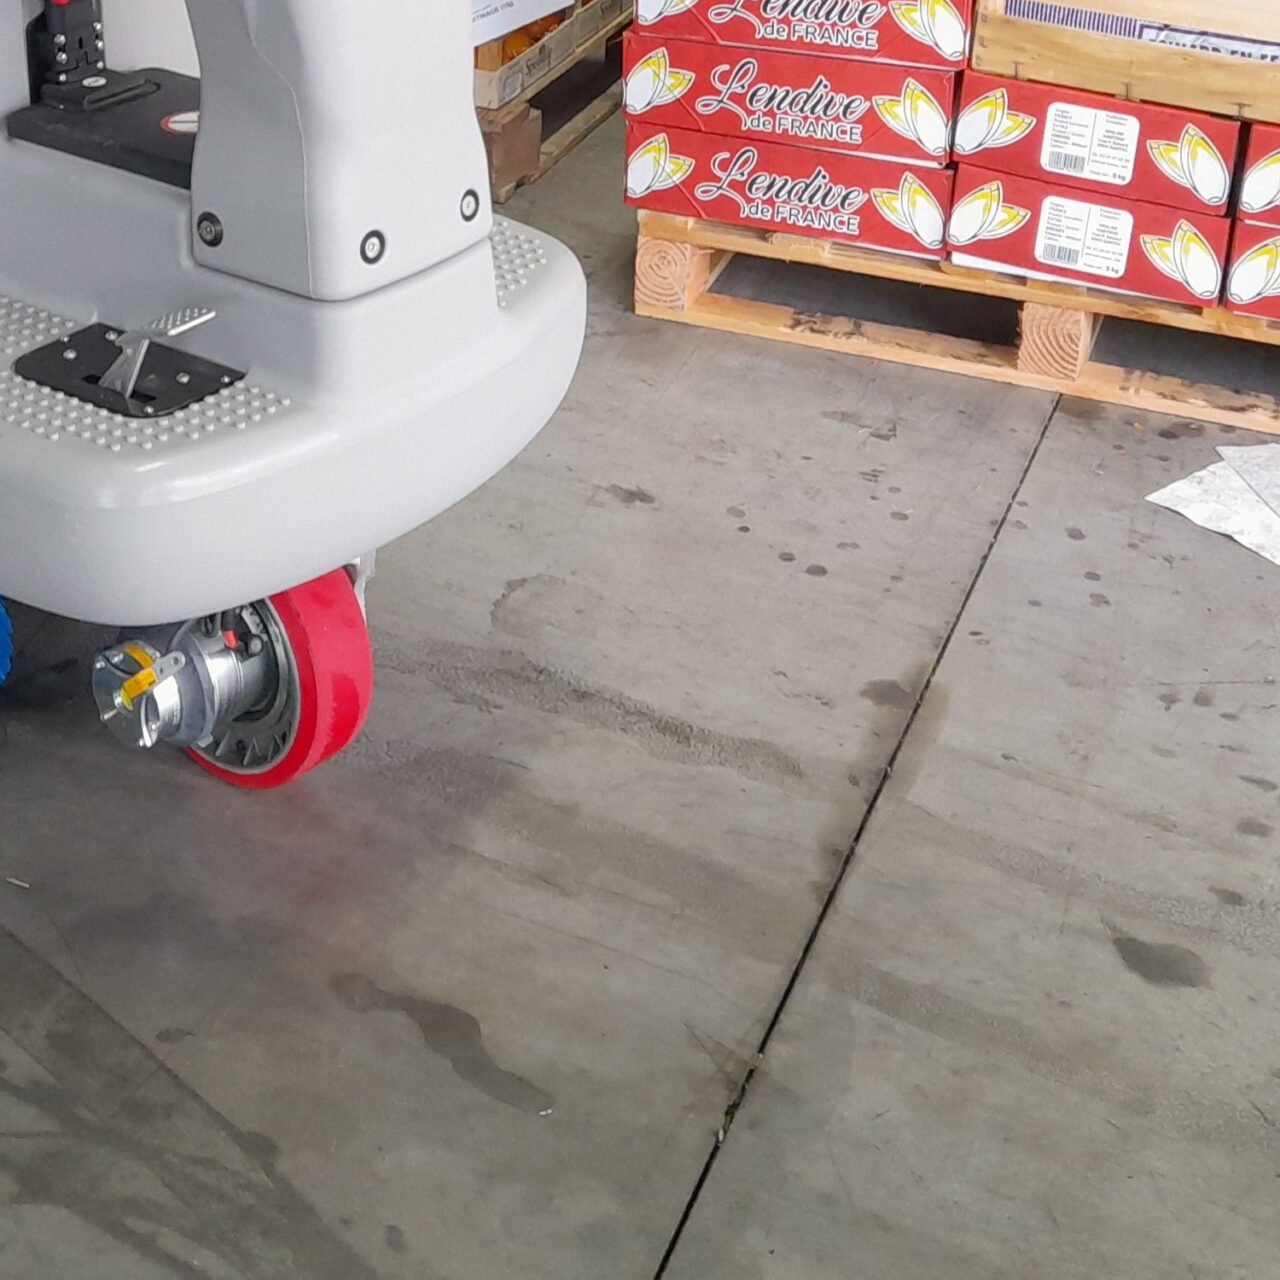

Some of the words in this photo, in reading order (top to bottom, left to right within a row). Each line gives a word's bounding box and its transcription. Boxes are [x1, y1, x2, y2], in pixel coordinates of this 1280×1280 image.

[762, 21, 787, 38] de
[792, 23, 878, 48] FRANCE
[749, 113, 772, 130] de
[777, 116, 862, 143] FRANCE
[748, 202, 771, 218] de
[775, 206, 859, 233] FRANCE
